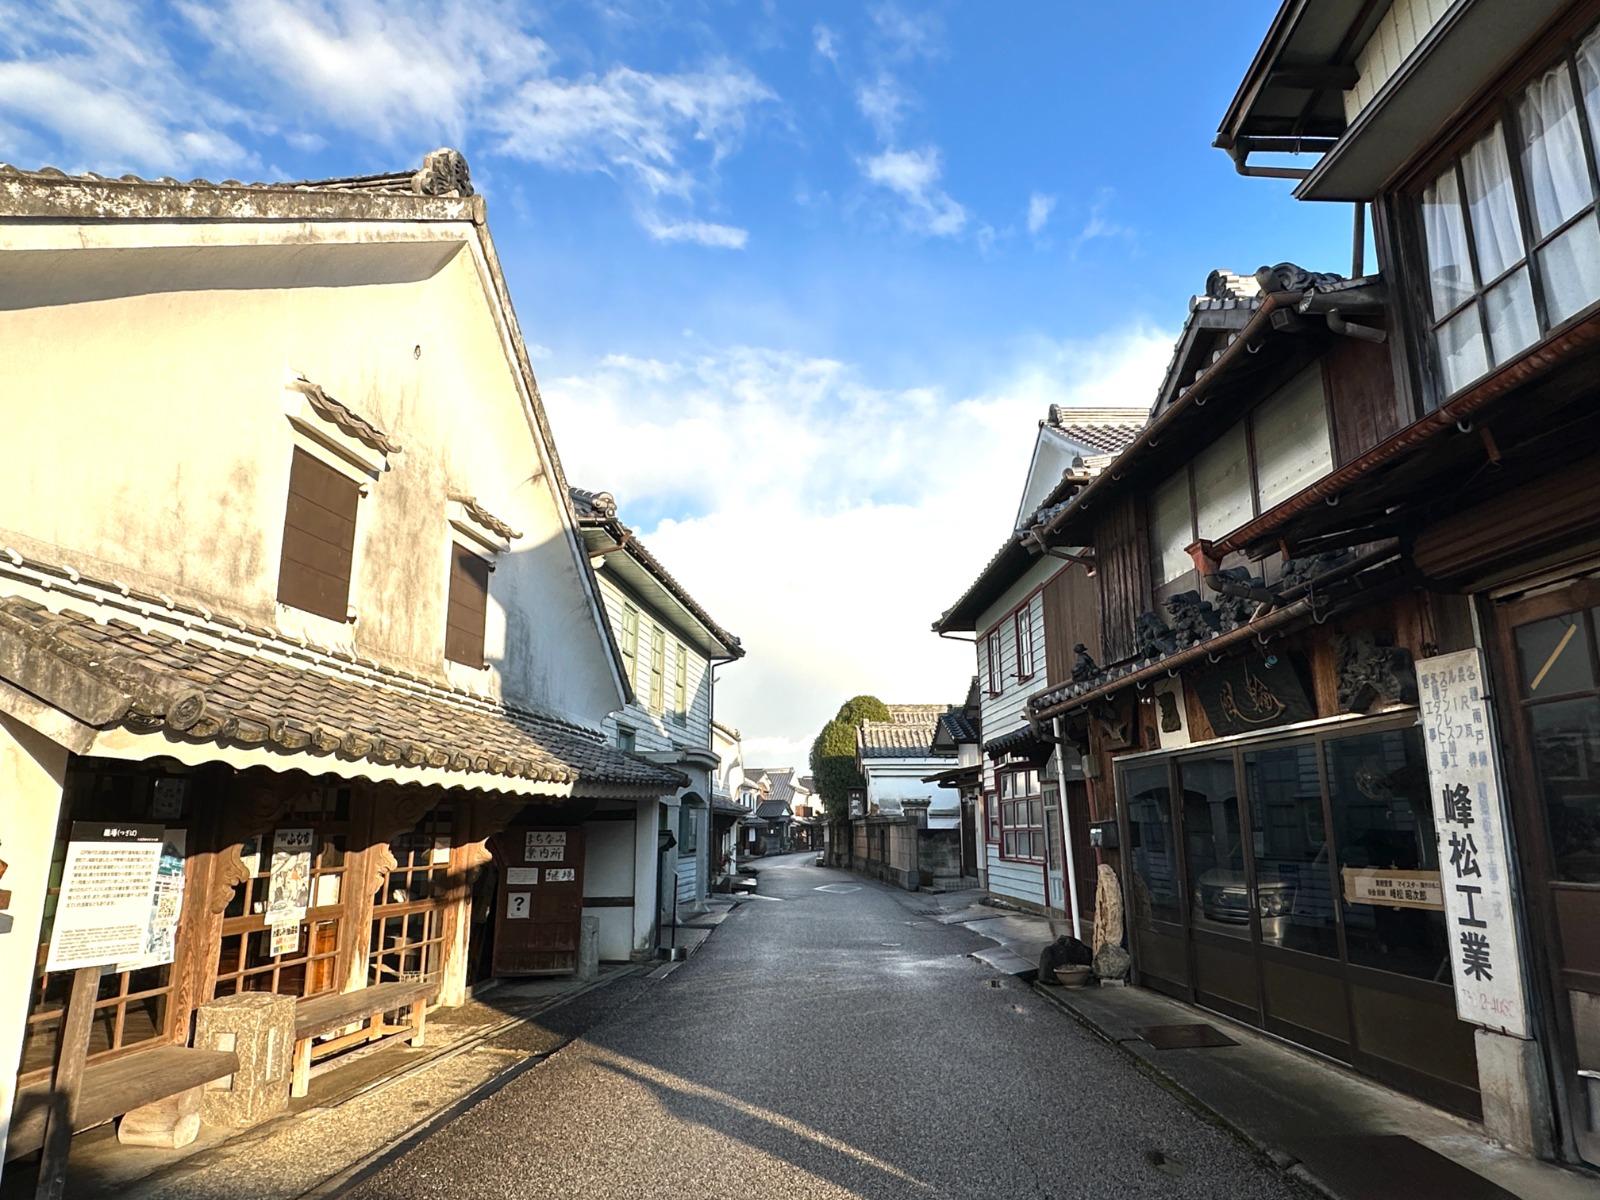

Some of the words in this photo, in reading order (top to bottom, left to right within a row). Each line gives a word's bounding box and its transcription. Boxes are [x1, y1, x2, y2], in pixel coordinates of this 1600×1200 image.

[527, 833, 565, 844] まちなみ
[526, 847, 562, 859] 案内所
[1442, 782, 1494, 982] 峰松工業
